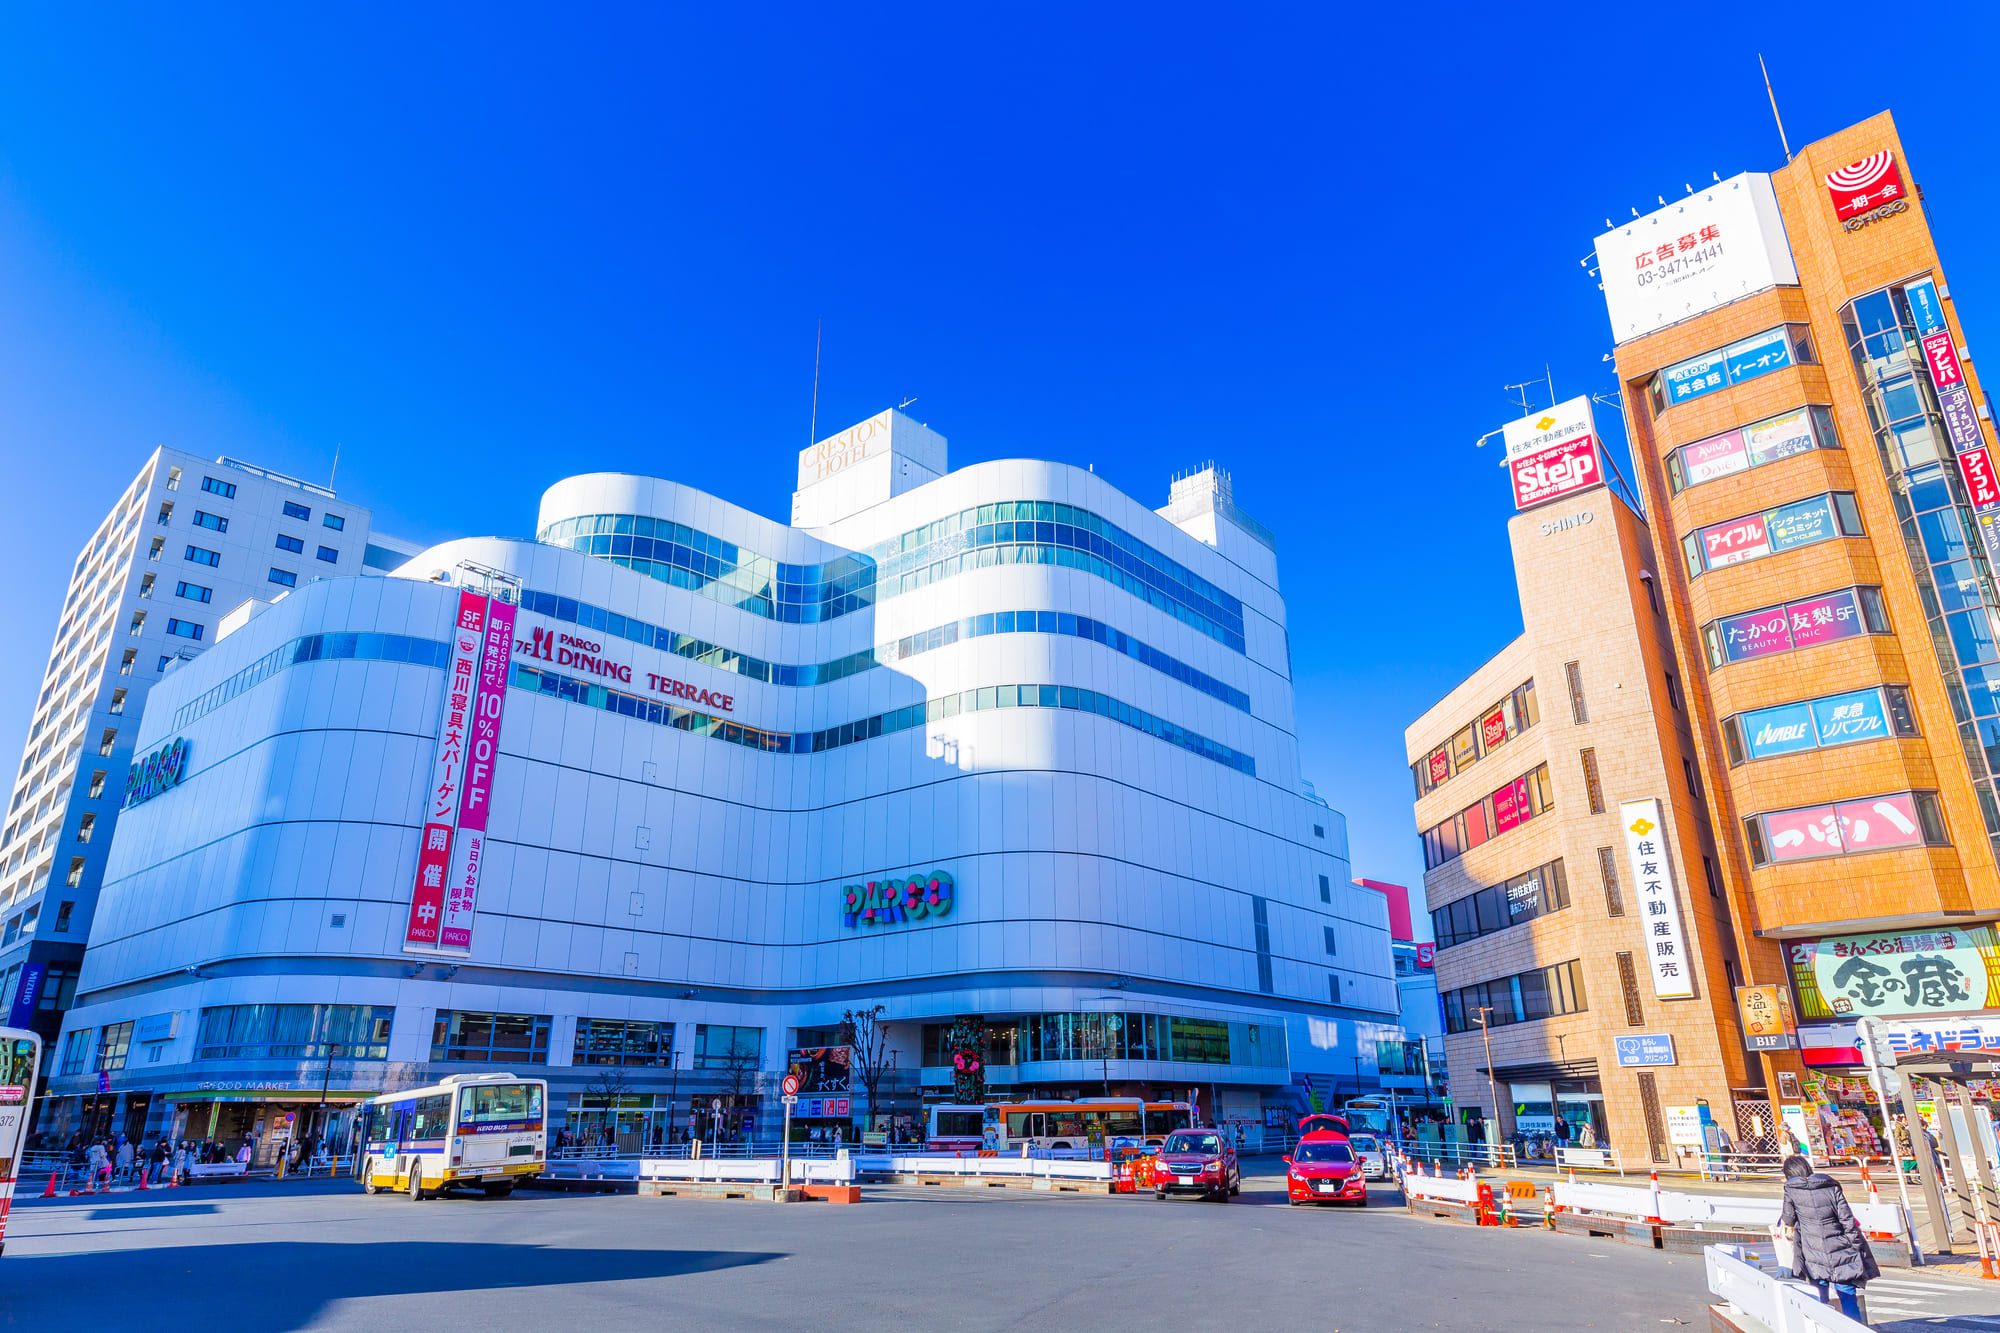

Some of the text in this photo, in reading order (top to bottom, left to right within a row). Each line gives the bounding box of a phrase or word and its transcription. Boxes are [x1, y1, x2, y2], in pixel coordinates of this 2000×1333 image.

[1838, 184, 1898, 212] 一期一会
[1635, 223, 1721, 271] 広告募集
[1637, 242, 1724, 287] 03-3471-4141
[1675, 361, 1710, 382] AEON
[1730, 350, 1786, 377] イーオン
[1932, 345, 1956, 382] アビバ
[1676, 371, 1721, 397] 英会話
[804, 411, 889, 468] CRESTON
[1512, 420, 1587, 454] 住友不動産販売
[1697, 438, 1732, 459] AVIVA
[818, 442, 866, 480] HOTEL
[1517, 453, 1593, 494] Step
[1965, 452, 1995, 502] アイフル
[1542, 510, 1594, 537] SHINO
[1769, 508, 1829, 530] インターネット
[1706, 523, 1763, 552] アイフル
[462, 610, 481, 623] 5F
[1728, 605, 1856, 644] たかの友梨 5F
[484, 617, 503, 686] 即日発行で
[515, 639, 532, 654] 7F
[560, 633, 601, 654] PARCO
[1741, 629, 1821, 652] BEAUTY CLINIC
[557, 647, 734, 712] DINING TERRACE
[1823, 715, 1882, 738] リバブル
[1831, 702, 1865, 722] 東急
[435, 657, 473, 817] 西川寝具大バーゲン
[121, 736, 186, 810] PARCO
[1772, 801, 1917, 849] つぼ八
[417, 828, 449, 924] 開催中
[461, 837, 481, 912] 当日のお買物
[448, 887, 463, 924] 限定！
[843, 869, 954, 928] PARCO
[1637, 841, 1679, 978] 住友不動産販売
[411, 927, 435, 938] PARCO
[444, 931, 468, 942] PARCO
[1834, 935, 1936, 957] きんくら酒場
[1791, 943, 1817, 964] 2F
[23, 970, 39, 1005] MIZUHO
[1832, 953, 1970, 1007] 金の蔵
[1755, 1036, 1778, 1047] B1F
[246, 1081, 291, 1090] MARKET
